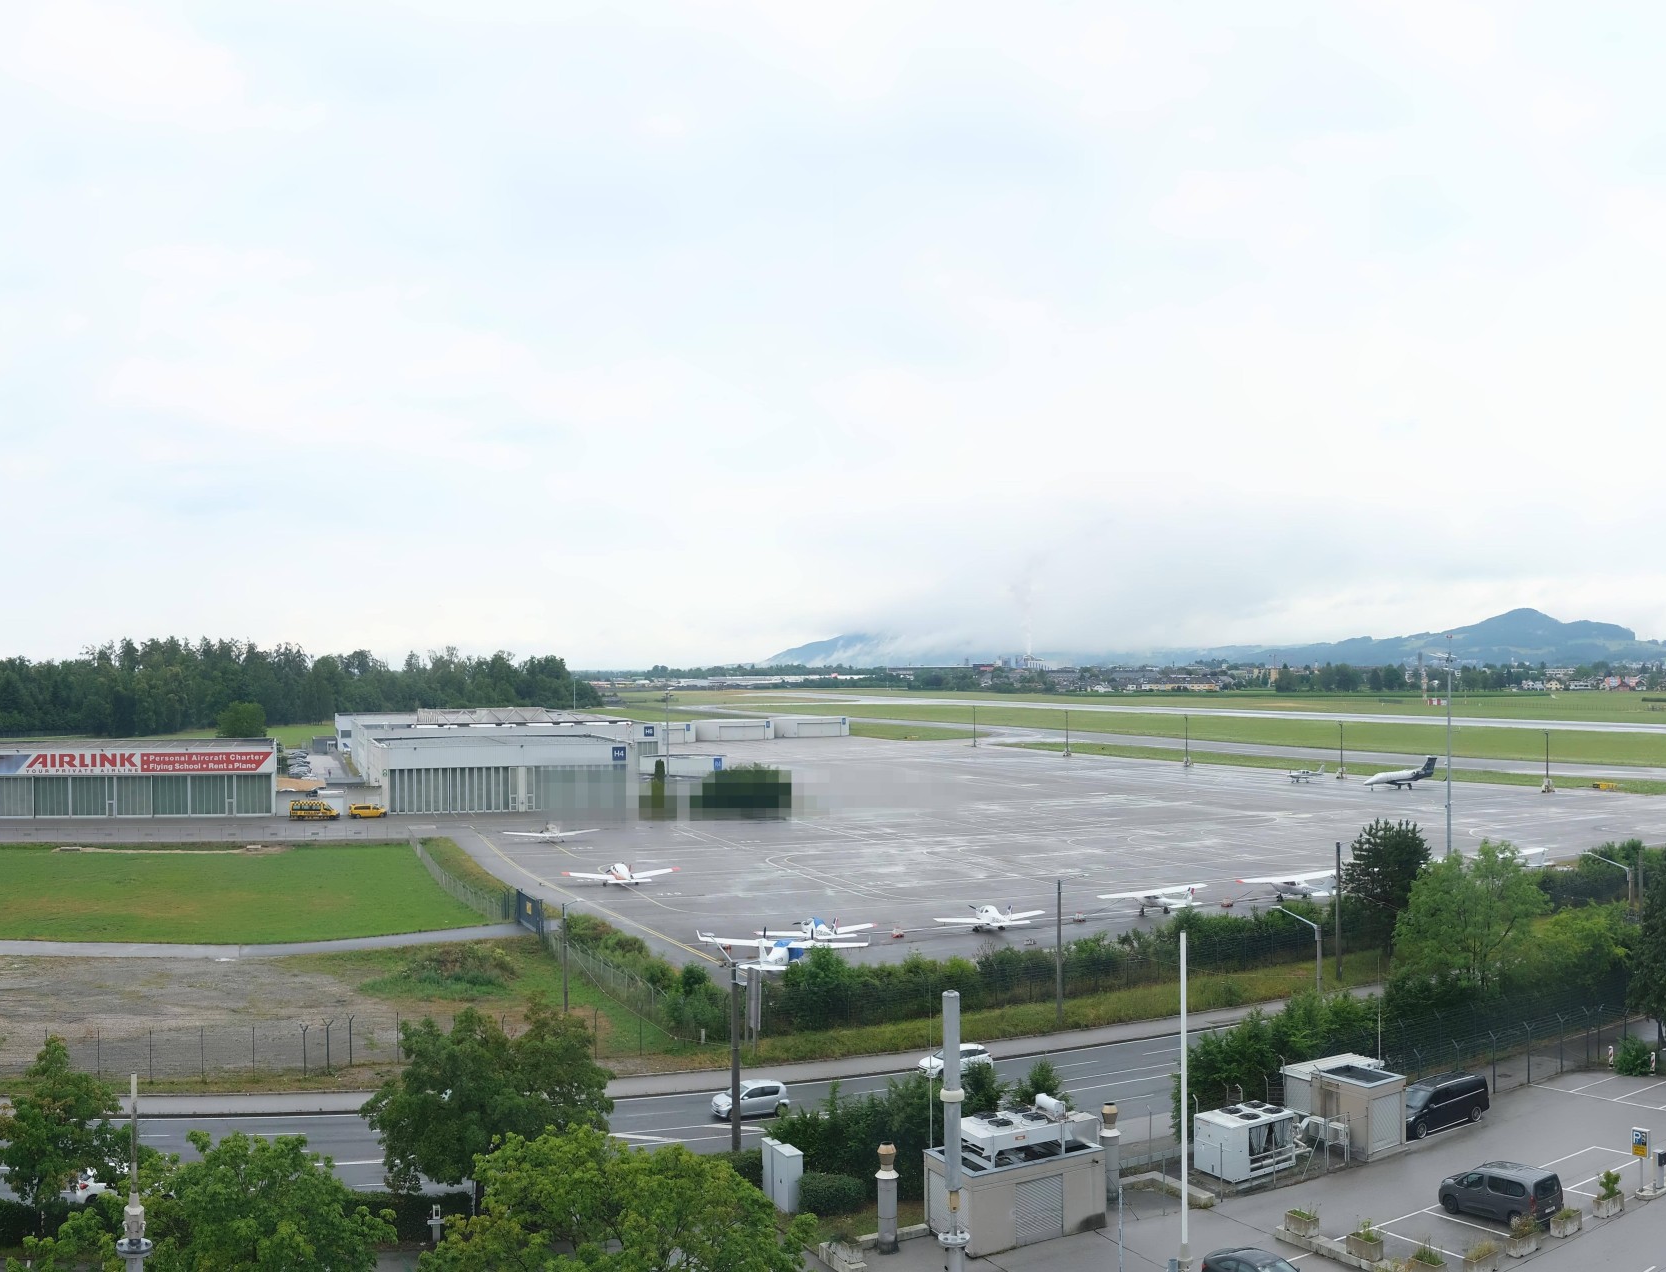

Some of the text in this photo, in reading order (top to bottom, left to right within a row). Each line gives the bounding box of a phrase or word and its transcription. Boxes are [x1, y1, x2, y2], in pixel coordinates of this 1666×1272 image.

[614, 748, 624, 758] H4
[26, 753, 138, 768] AIRLINK
[149, 763, 173, 771] Flying
[1633, 1131, 1641, 1144] P
